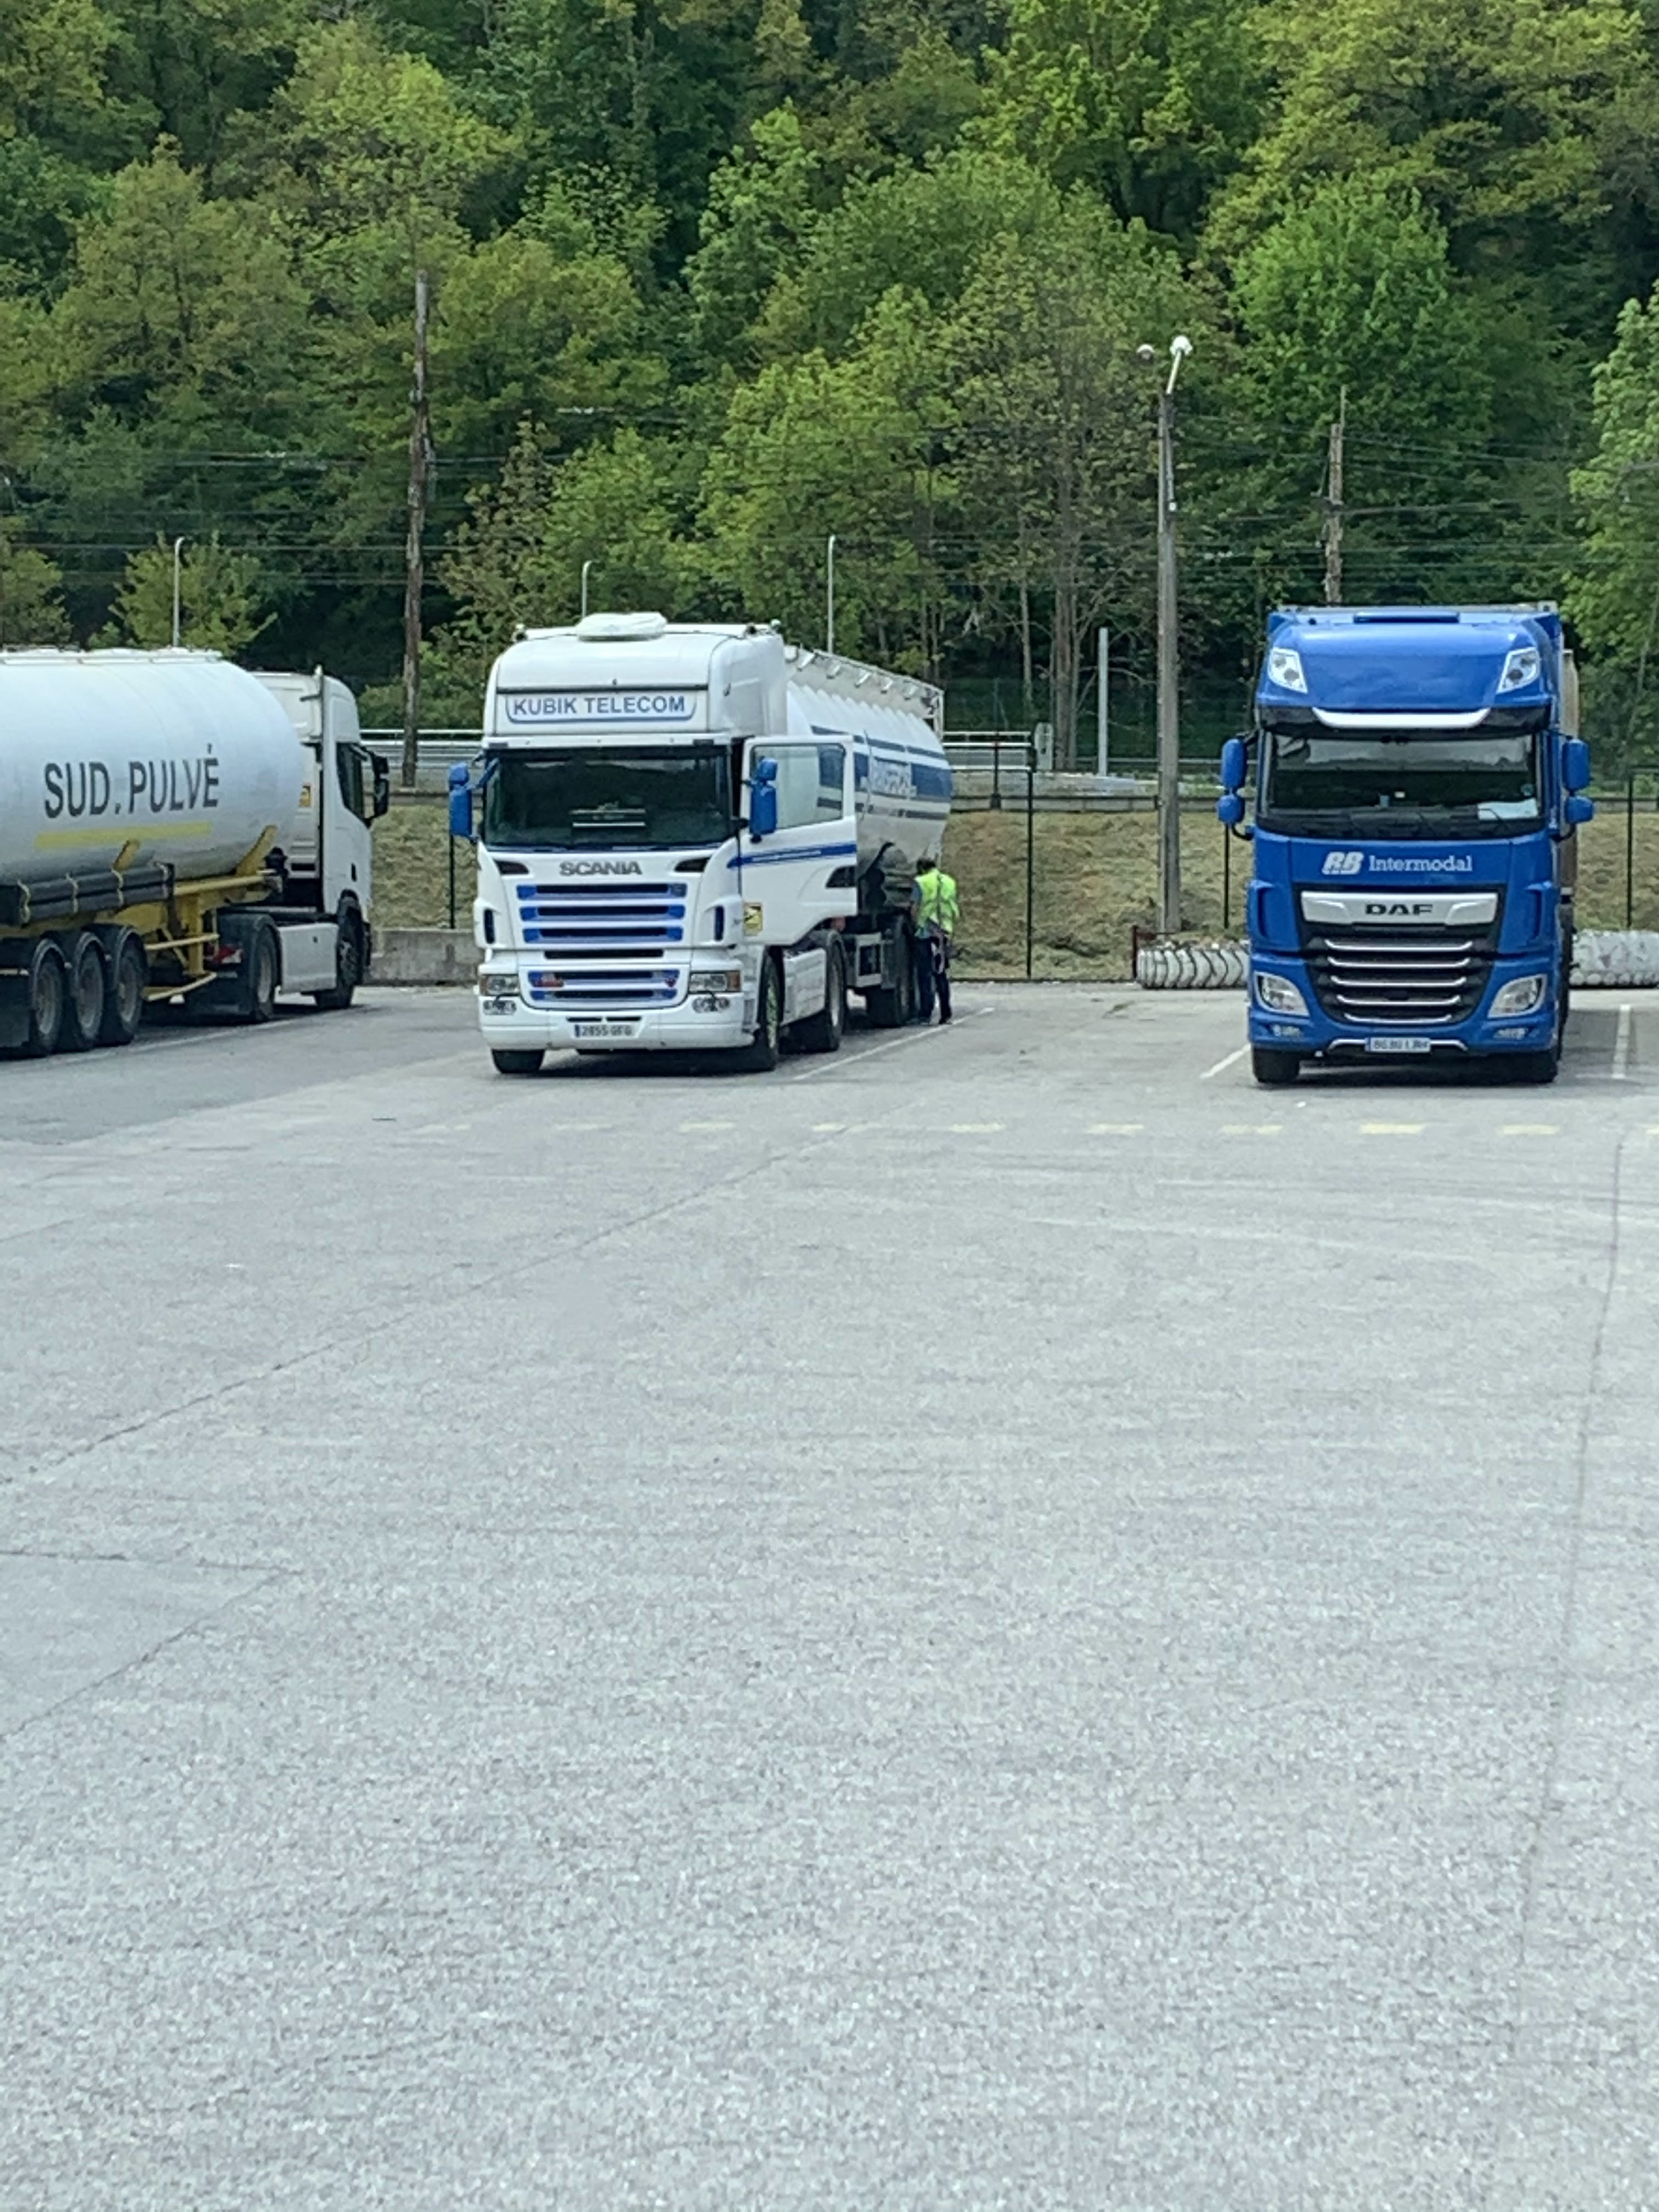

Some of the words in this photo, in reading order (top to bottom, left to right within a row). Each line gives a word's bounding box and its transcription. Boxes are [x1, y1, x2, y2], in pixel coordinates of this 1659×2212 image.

[514, 697, 577, 714] KUBIK
[584, 695, 685, 713] TELECOM
[560, 861, 642, 876] SCANIA
[1368, 855, 1473, 872] Intermodal
[1365, 904, 1433, 916] DAF
